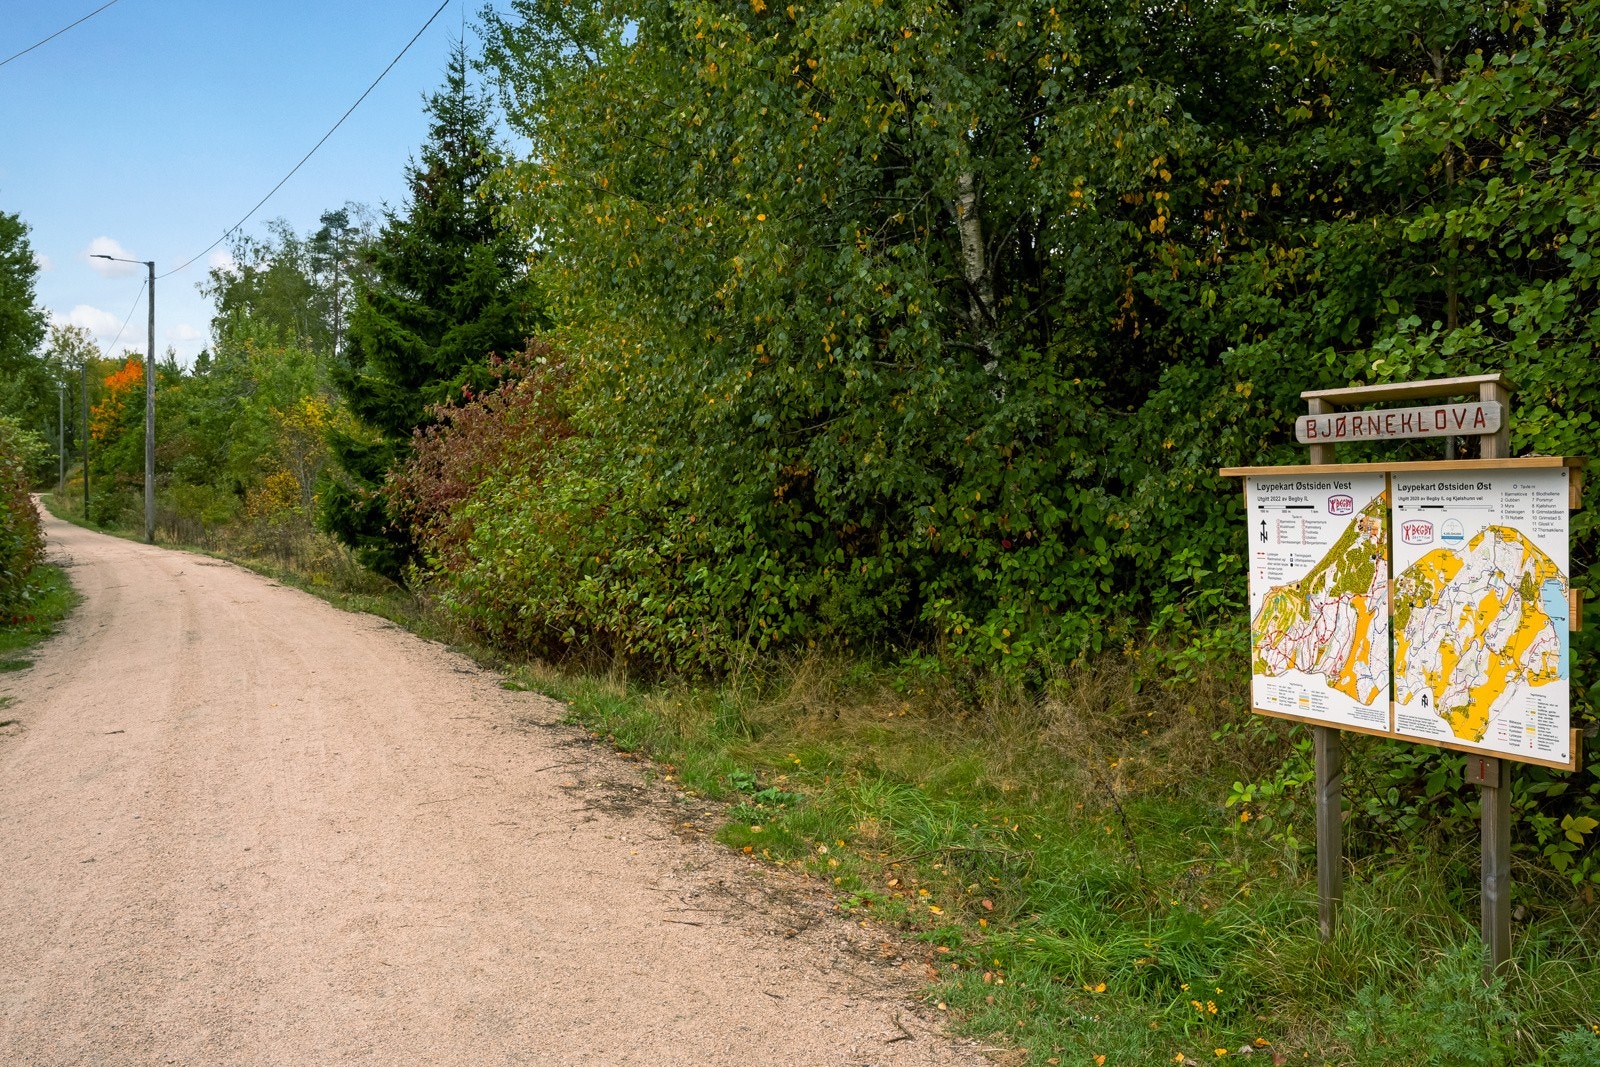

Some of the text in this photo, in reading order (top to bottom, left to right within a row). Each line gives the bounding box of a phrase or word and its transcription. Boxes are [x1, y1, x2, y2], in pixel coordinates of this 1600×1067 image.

[1306, 406, 1486, 439] BJØRNEKLOVA
[1256, 481, 1352, 492] Løypekart Østsiden Vest
[1397, 482, 1492, 492] Løypekart Østsiden Øst
[1412, 524, 1431, 535] BEGBY
